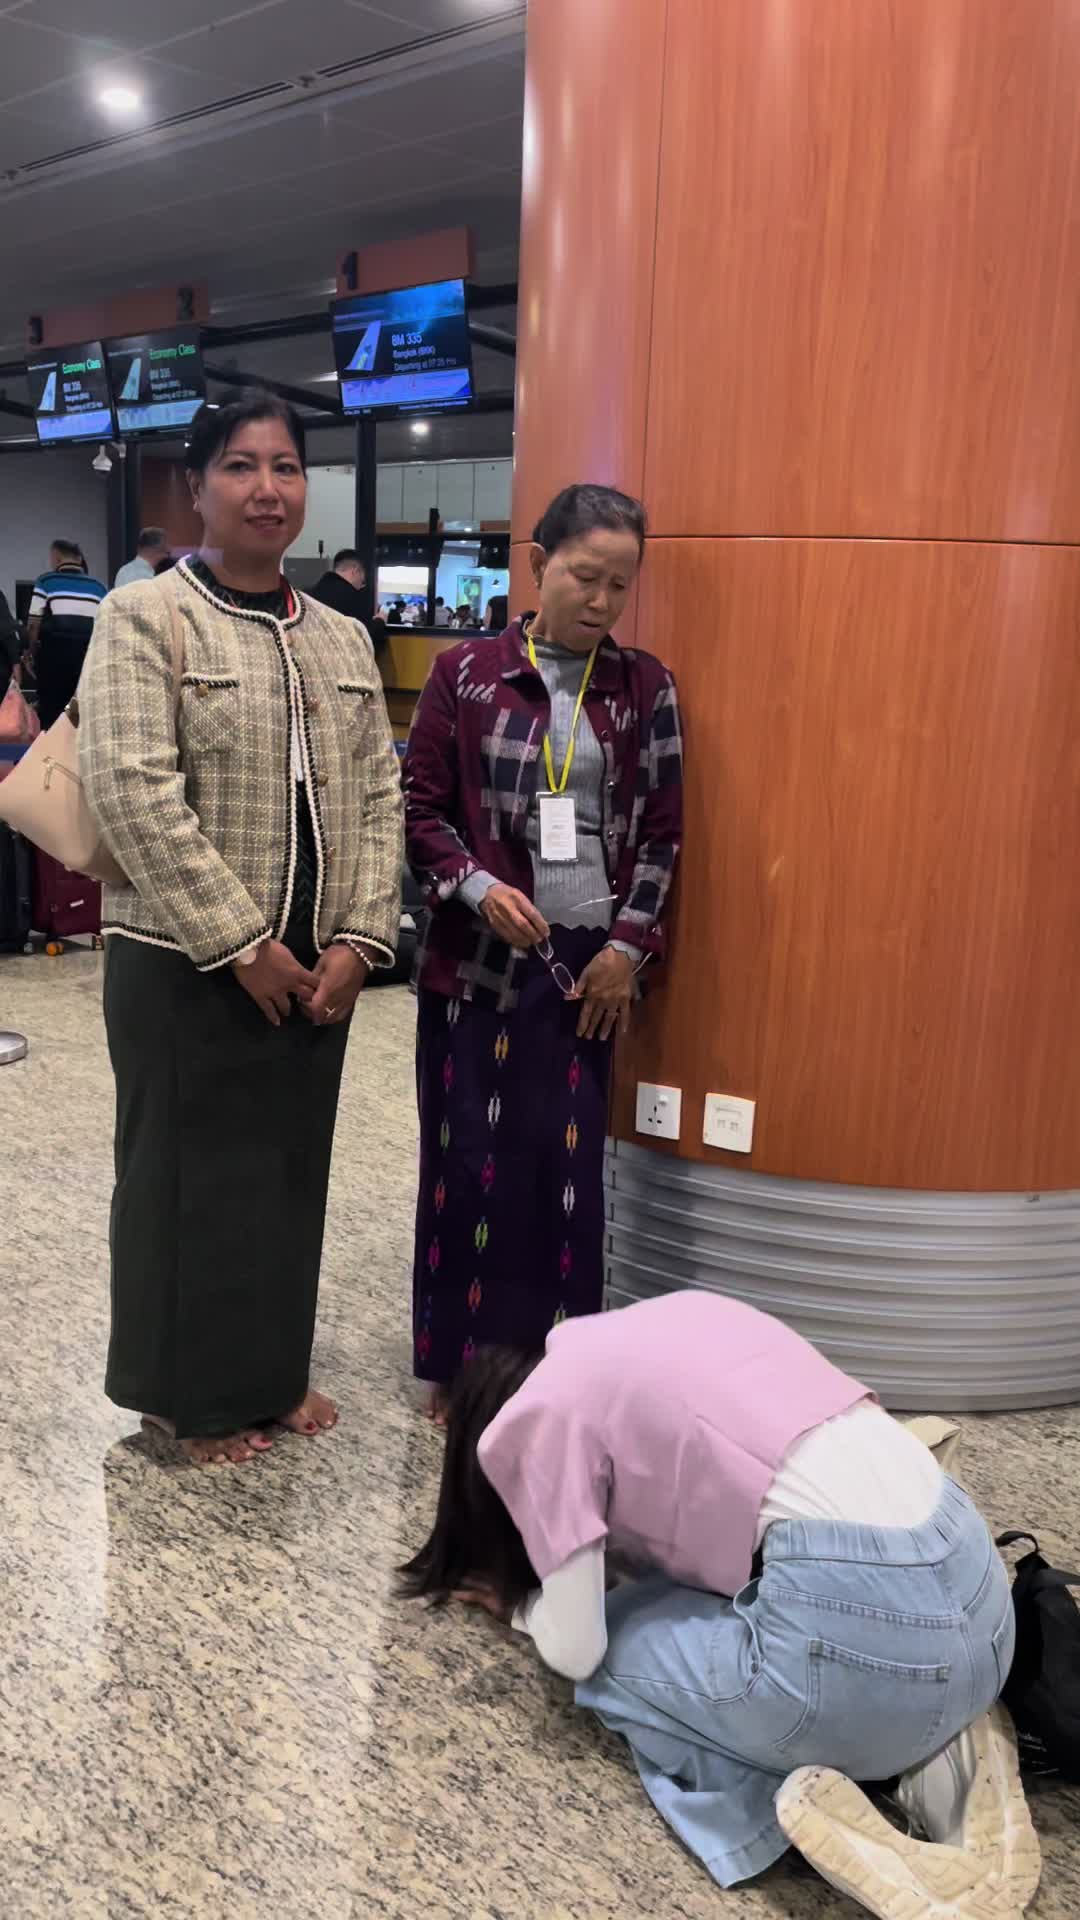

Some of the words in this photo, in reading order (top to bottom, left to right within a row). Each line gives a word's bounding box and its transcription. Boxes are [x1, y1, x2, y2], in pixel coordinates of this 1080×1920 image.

[342, 251, 358, 289] 1
[178, 288, 193, 320] 2
[178, 343, 197, 356] Class
[391, 334, 405, 346] BM
[406, 332, 423, 345] 335
